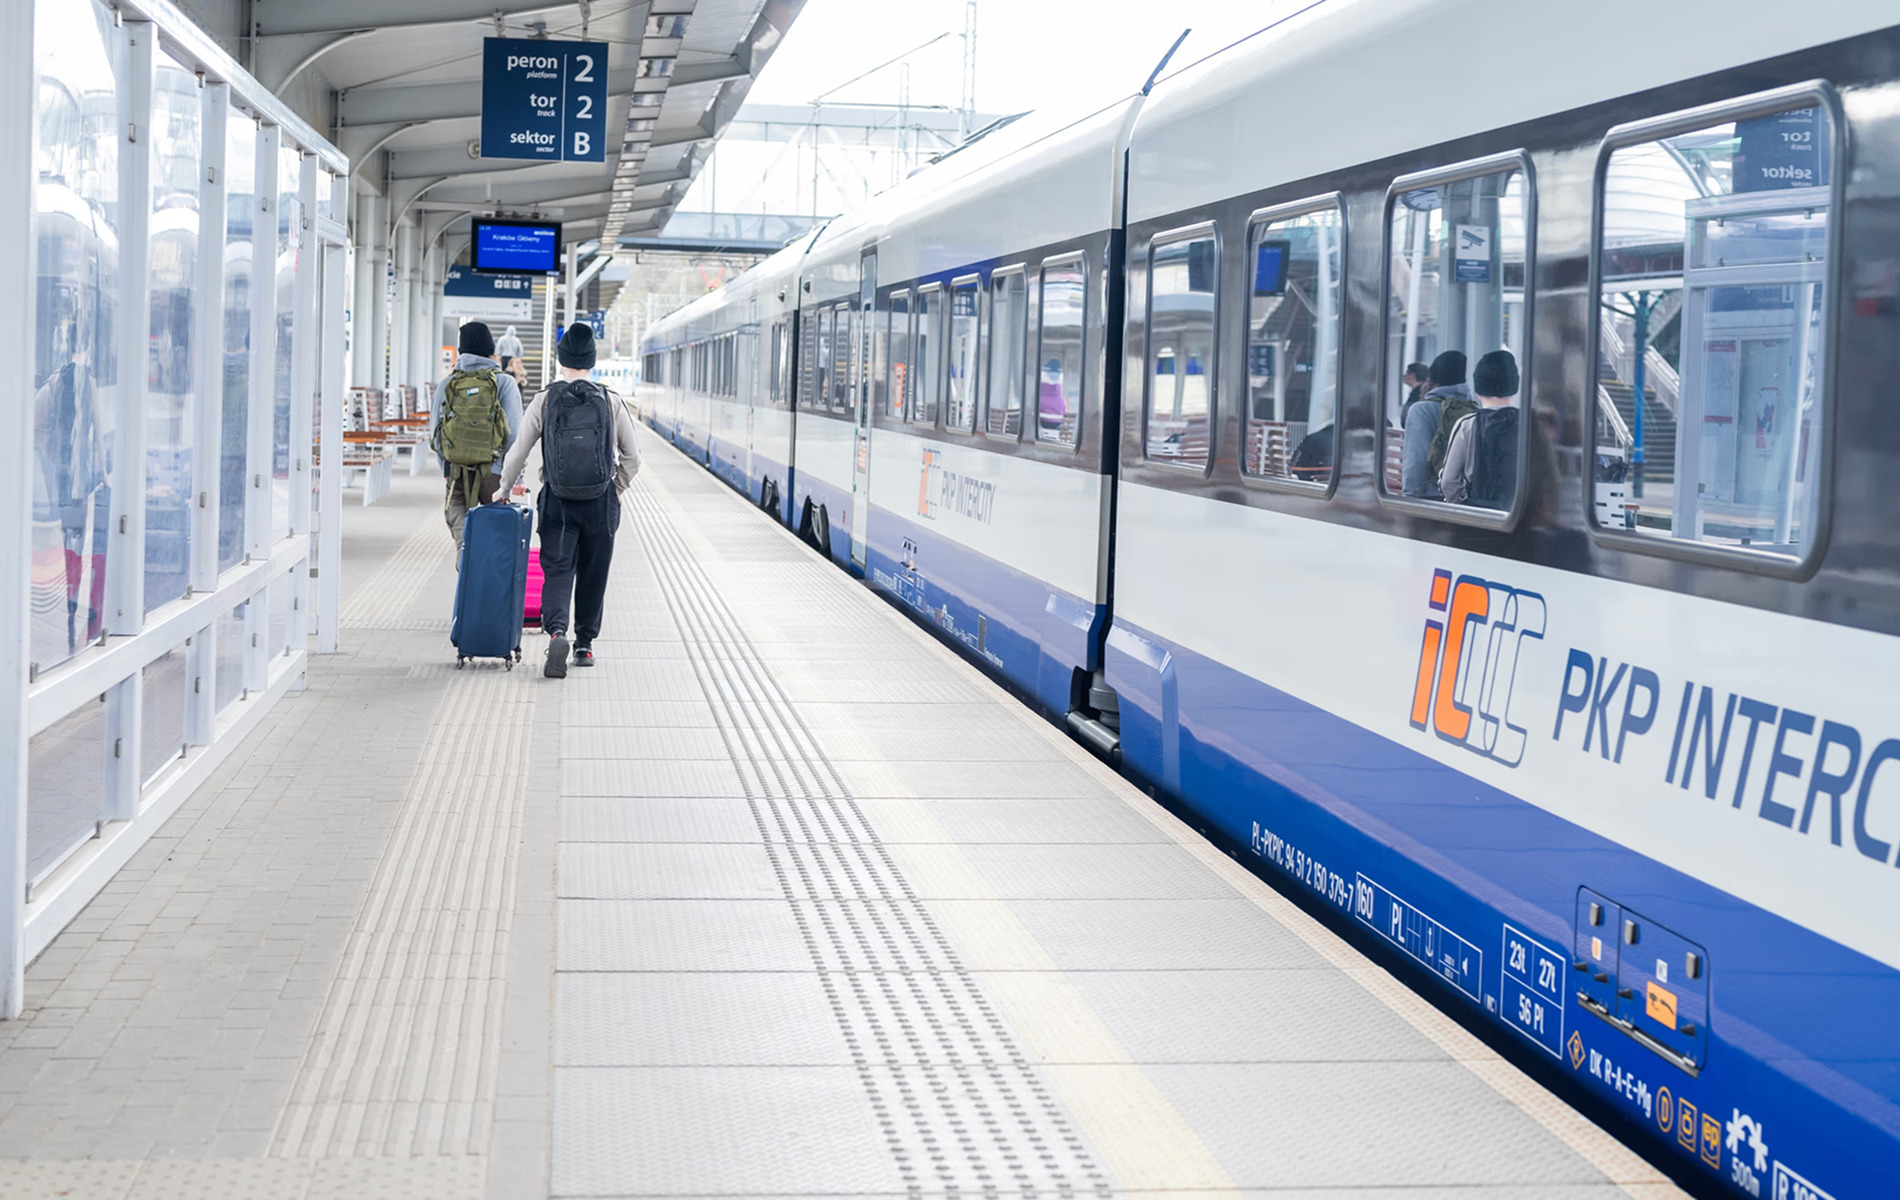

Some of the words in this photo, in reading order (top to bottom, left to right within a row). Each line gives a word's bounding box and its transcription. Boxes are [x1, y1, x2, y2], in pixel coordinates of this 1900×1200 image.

[507, 55, 558, 71] peron
[574, 54, 594, 82] 2
[526, 71, 557, 79] platform
[529, 93, 557, 108] tor
[576, 95, 592, 119] 2
[537, 109, 556, 117] track
[510, 130, 555, 145] sektor
[574, 132, 591, 155] B
[940, 470, 957, 510] PKP
[955, 475, 996, 526] INTERCITY
[1552, 647, 1660, 765] PKP
[1664, 681, 1900, 869] INTERC
[1252, 820, 1285, 867] PL-PKPIC
[1285, 843, 1295, 874] 94
[1296, 850, 1305, 880] 51
[1306, 856, 1313, 886] 2
[1313, 861, 1327, 895] 150
[1328, 871, 1354, 912] 379-7
[1357, 880, 1374, 919] 160
[1391, 902, 1405, 944] PL
[1510, 940, 1526, 974] 23t
[1538, 958, 1556, 993] 27t
[1518, 993, 1532, 1026] 56
[1590, 1048, 1603, 1079] DK
[1604, 1058, 1652, 1118] R-A-E-Mg
[1703, 1122, 1718, 1150] ep
[1731, 1156, 1760, 1198] 500m
